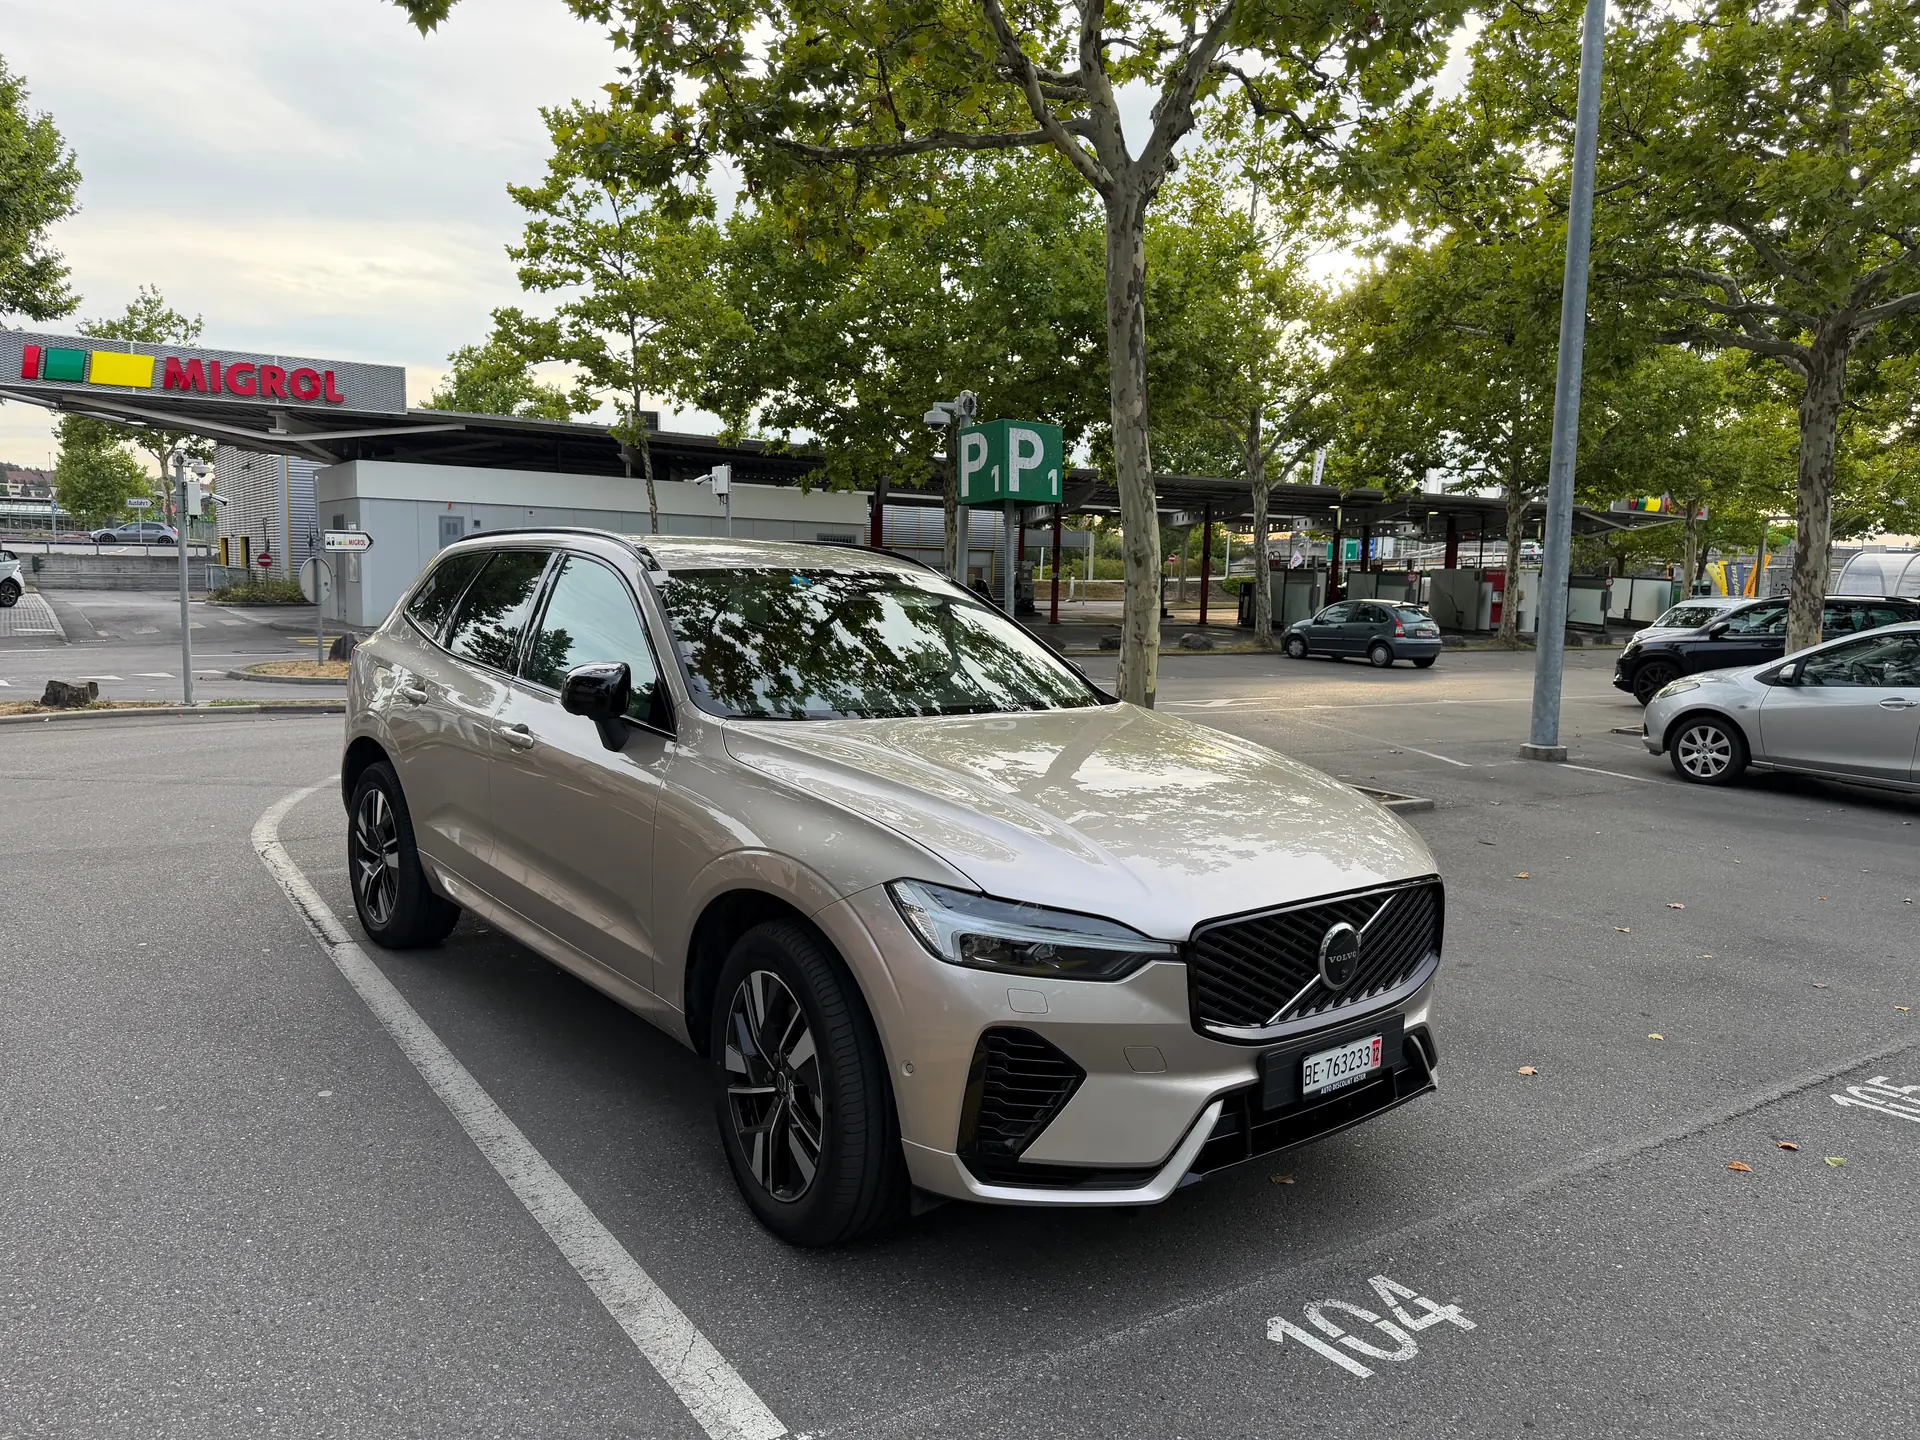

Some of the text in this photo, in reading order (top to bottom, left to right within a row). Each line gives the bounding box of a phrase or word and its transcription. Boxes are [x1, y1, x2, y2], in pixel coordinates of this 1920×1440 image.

[163, 356, 344, 403] MIGROL
[1328, 950, 1357, 964] VOLVO
[1372, 1046, 1380, 1063] 12
[1320, 1072, 1367, 1095] AUTO DISCOUNT USTER
[1266, 1274, 1478, 1379] 104
